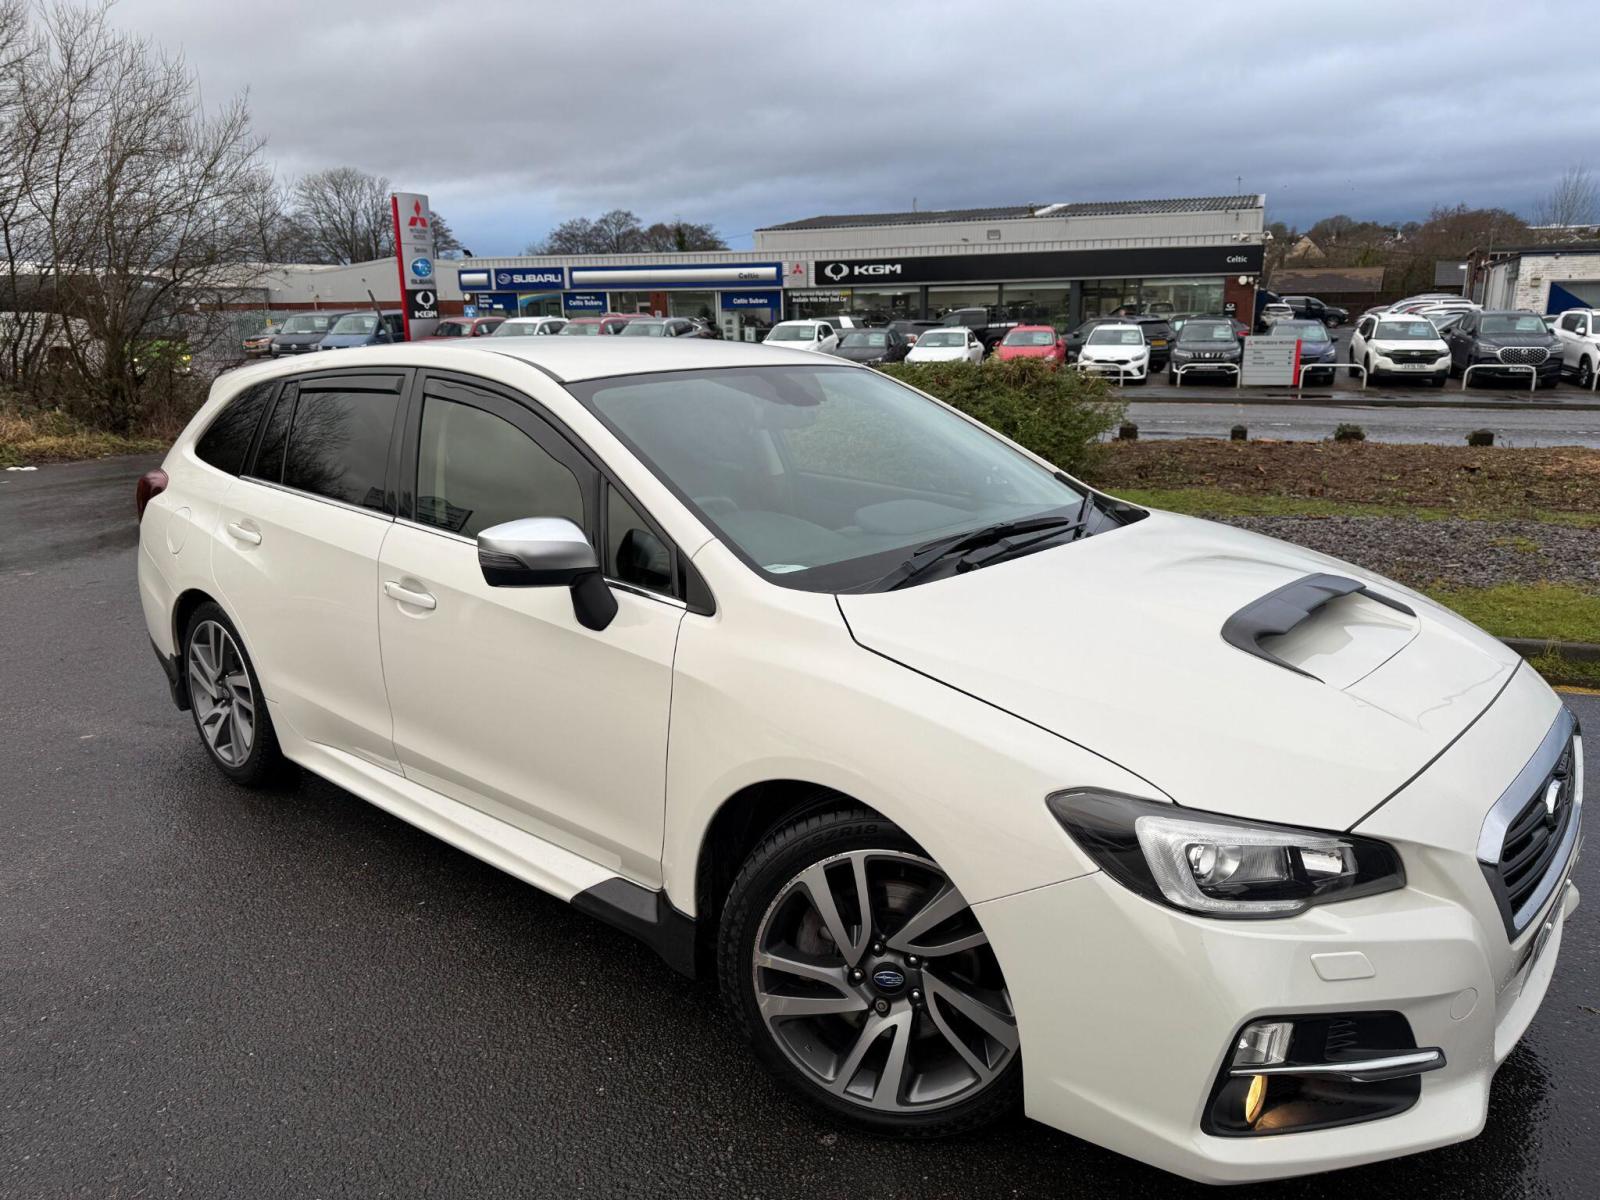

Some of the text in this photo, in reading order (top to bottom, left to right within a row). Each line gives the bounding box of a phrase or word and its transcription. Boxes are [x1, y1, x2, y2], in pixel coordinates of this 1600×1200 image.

[854, 264, 902, 276] KGM
[512, 273, 562, 283] SUBARU
[414, 310, 438, 318] KGM
